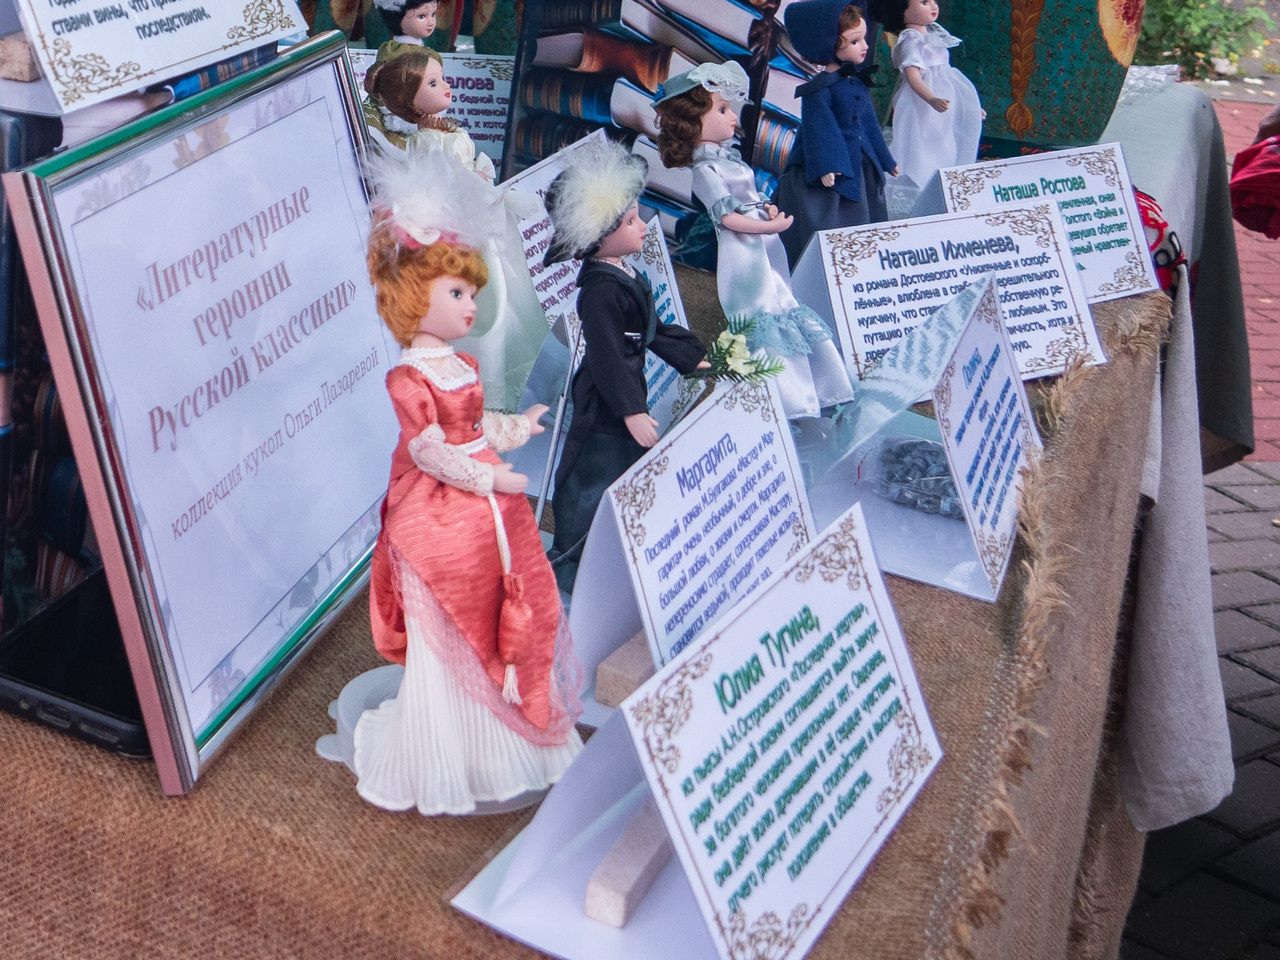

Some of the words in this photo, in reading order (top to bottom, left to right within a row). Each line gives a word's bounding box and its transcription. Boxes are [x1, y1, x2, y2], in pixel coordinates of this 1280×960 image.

[52, 11, 93, 36] ствами
[93, 3, 129, 25] вины,
[135, 6, 211, 40] последствиям.
[444, 75, 494, 90] алова
[992, 182, 1039, 203] Наташа
[1039, 175, 1086, 195] Ростова
[1065, 212, 1092, 225] олстого
[136, 185, 312, 313] «Литературные
[878, 246, 939, 270] Наташа
[940, 235, 1019, 261] Ихменева,
[852, 283, 864, 293] из
[866, 278, 898, 294] романа
[900, 268, 958, 288] Достоевского
[1014, 258, 1019, 268] и
[1020, 252, 1051, 267] оскорб-
[897, 288, 940, 304] влюблена
[943, 287, 949, 296] в
[997, 269, 1059, 287] ерешительного
[192, 260, 292, 348] героини
[857, 313, 900, 329] мужчину,
[901, 309, 918, 319] что
[863, 328, 902, 345] путацию
[1052, 299, 1067, 311] Это
[147, 346, 250, 454] Русской
[250, 279, 357, 374] классики»
[171, 463, 244, 541] коллекция
[244, 428, 284, 480] кукол
[283, 394, 322, 440] Ольги
[320, 346, 380, 410] Лазаревой
[676, 432, 737, 498] Маргарита,
[713, 652, 765, 715] Юлия
[759, 604, 819, 668] Тугина,
